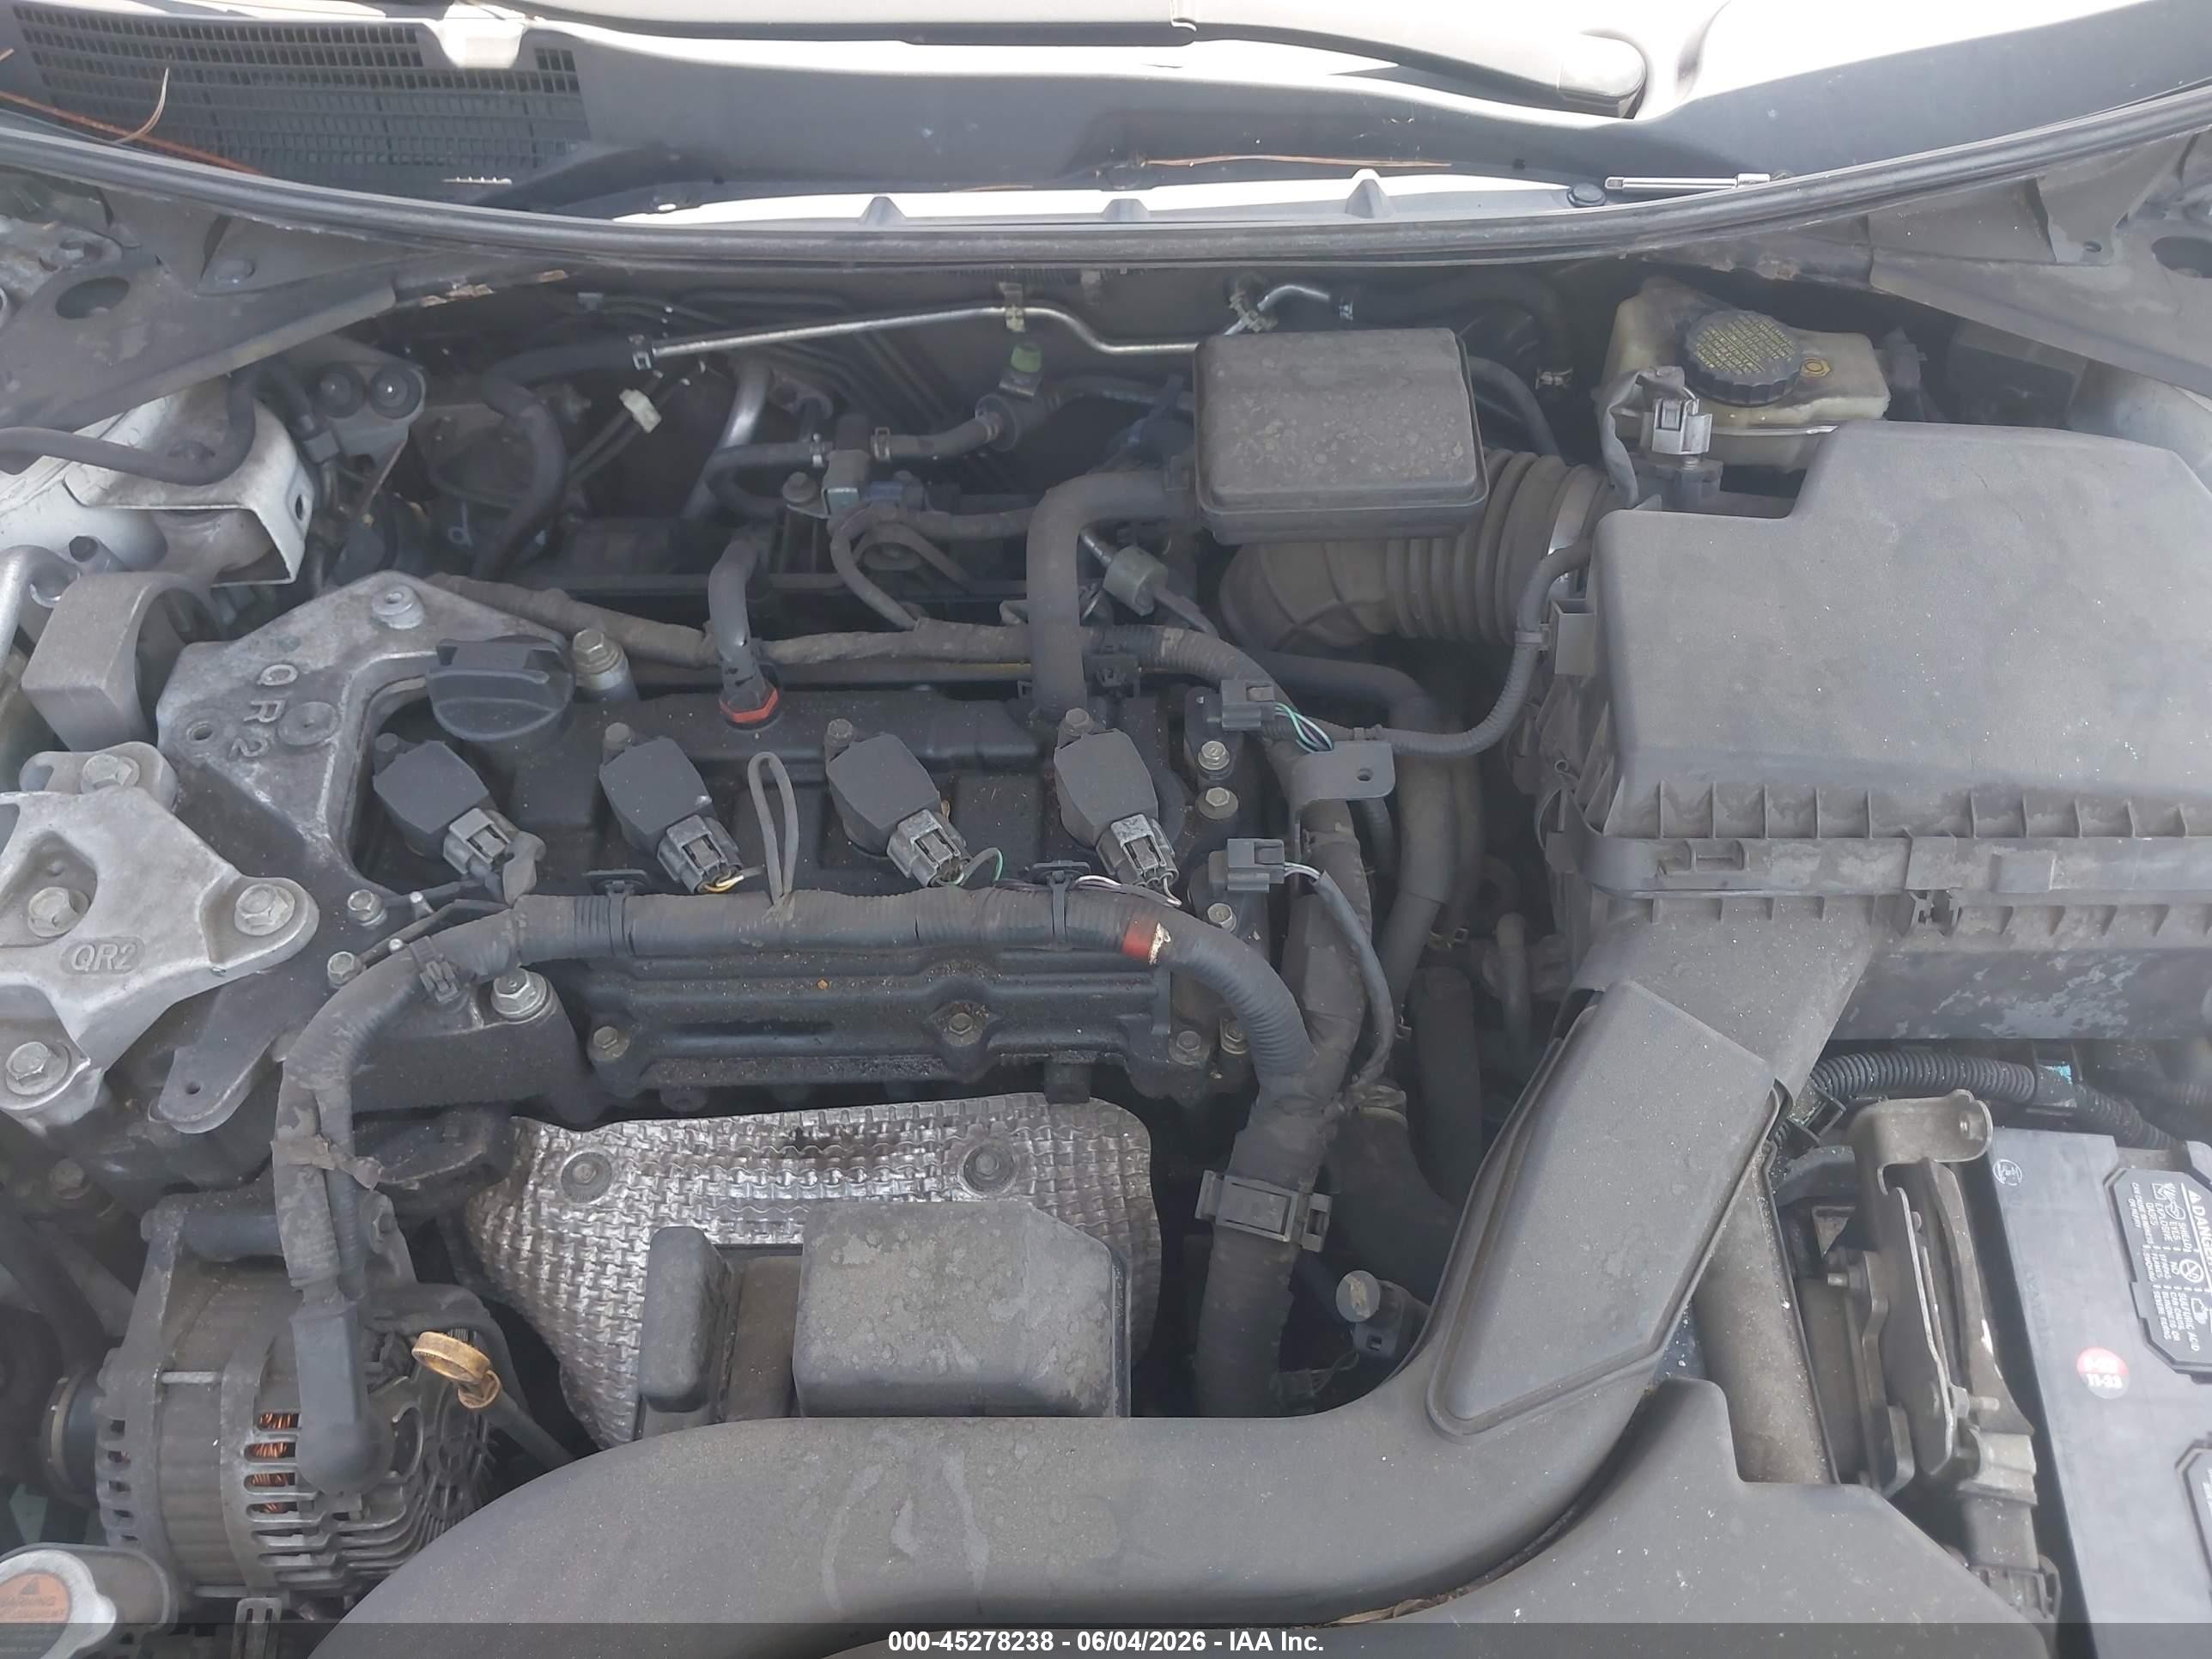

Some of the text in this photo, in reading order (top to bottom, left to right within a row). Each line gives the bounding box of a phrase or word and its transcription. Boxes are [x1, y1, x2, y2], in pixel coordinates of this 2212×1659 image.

[70, 943, 137, 971] QR2
[2169, 1221, 2181, 1241] EYES
[2179, 1222, 2191, 1249] SHIELD
[2177, 1292, 2200, 1352] SULFURIC ACID
